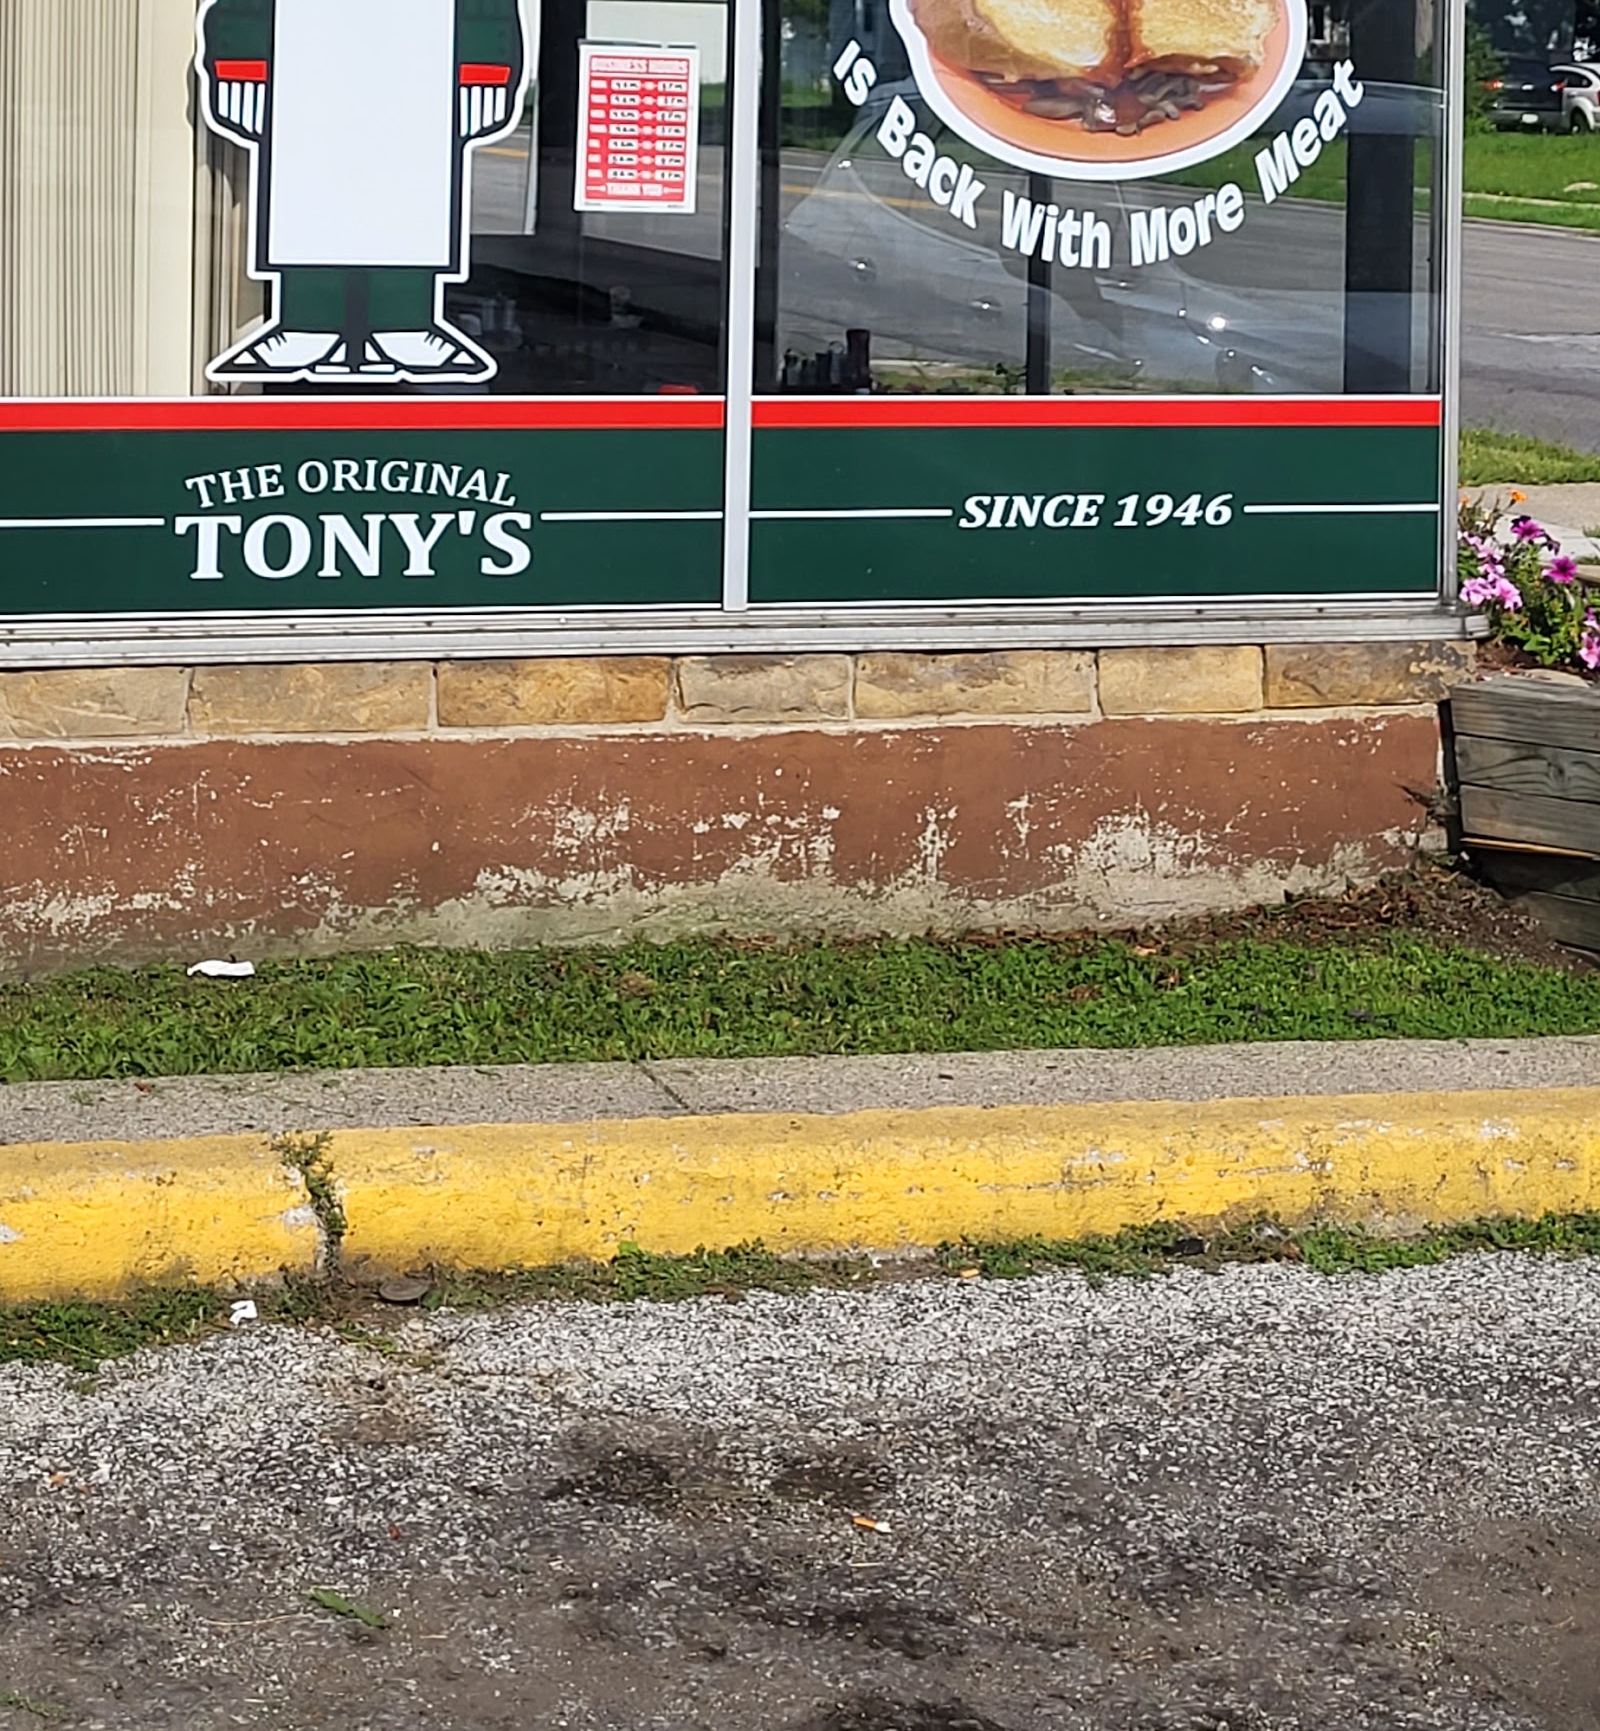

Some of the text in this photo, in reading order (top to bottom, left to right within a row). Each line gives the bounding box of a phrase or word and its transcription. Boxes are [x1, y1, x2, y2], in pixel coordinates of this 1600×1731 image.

[833, 39, 1365, 270] Is Back With More Meat
[184, 458, 518, 509] THE ORIGINAL
[957, 493, 1234, 529] SINCE 1946
[174, 509, 533, 580] TONY'S
